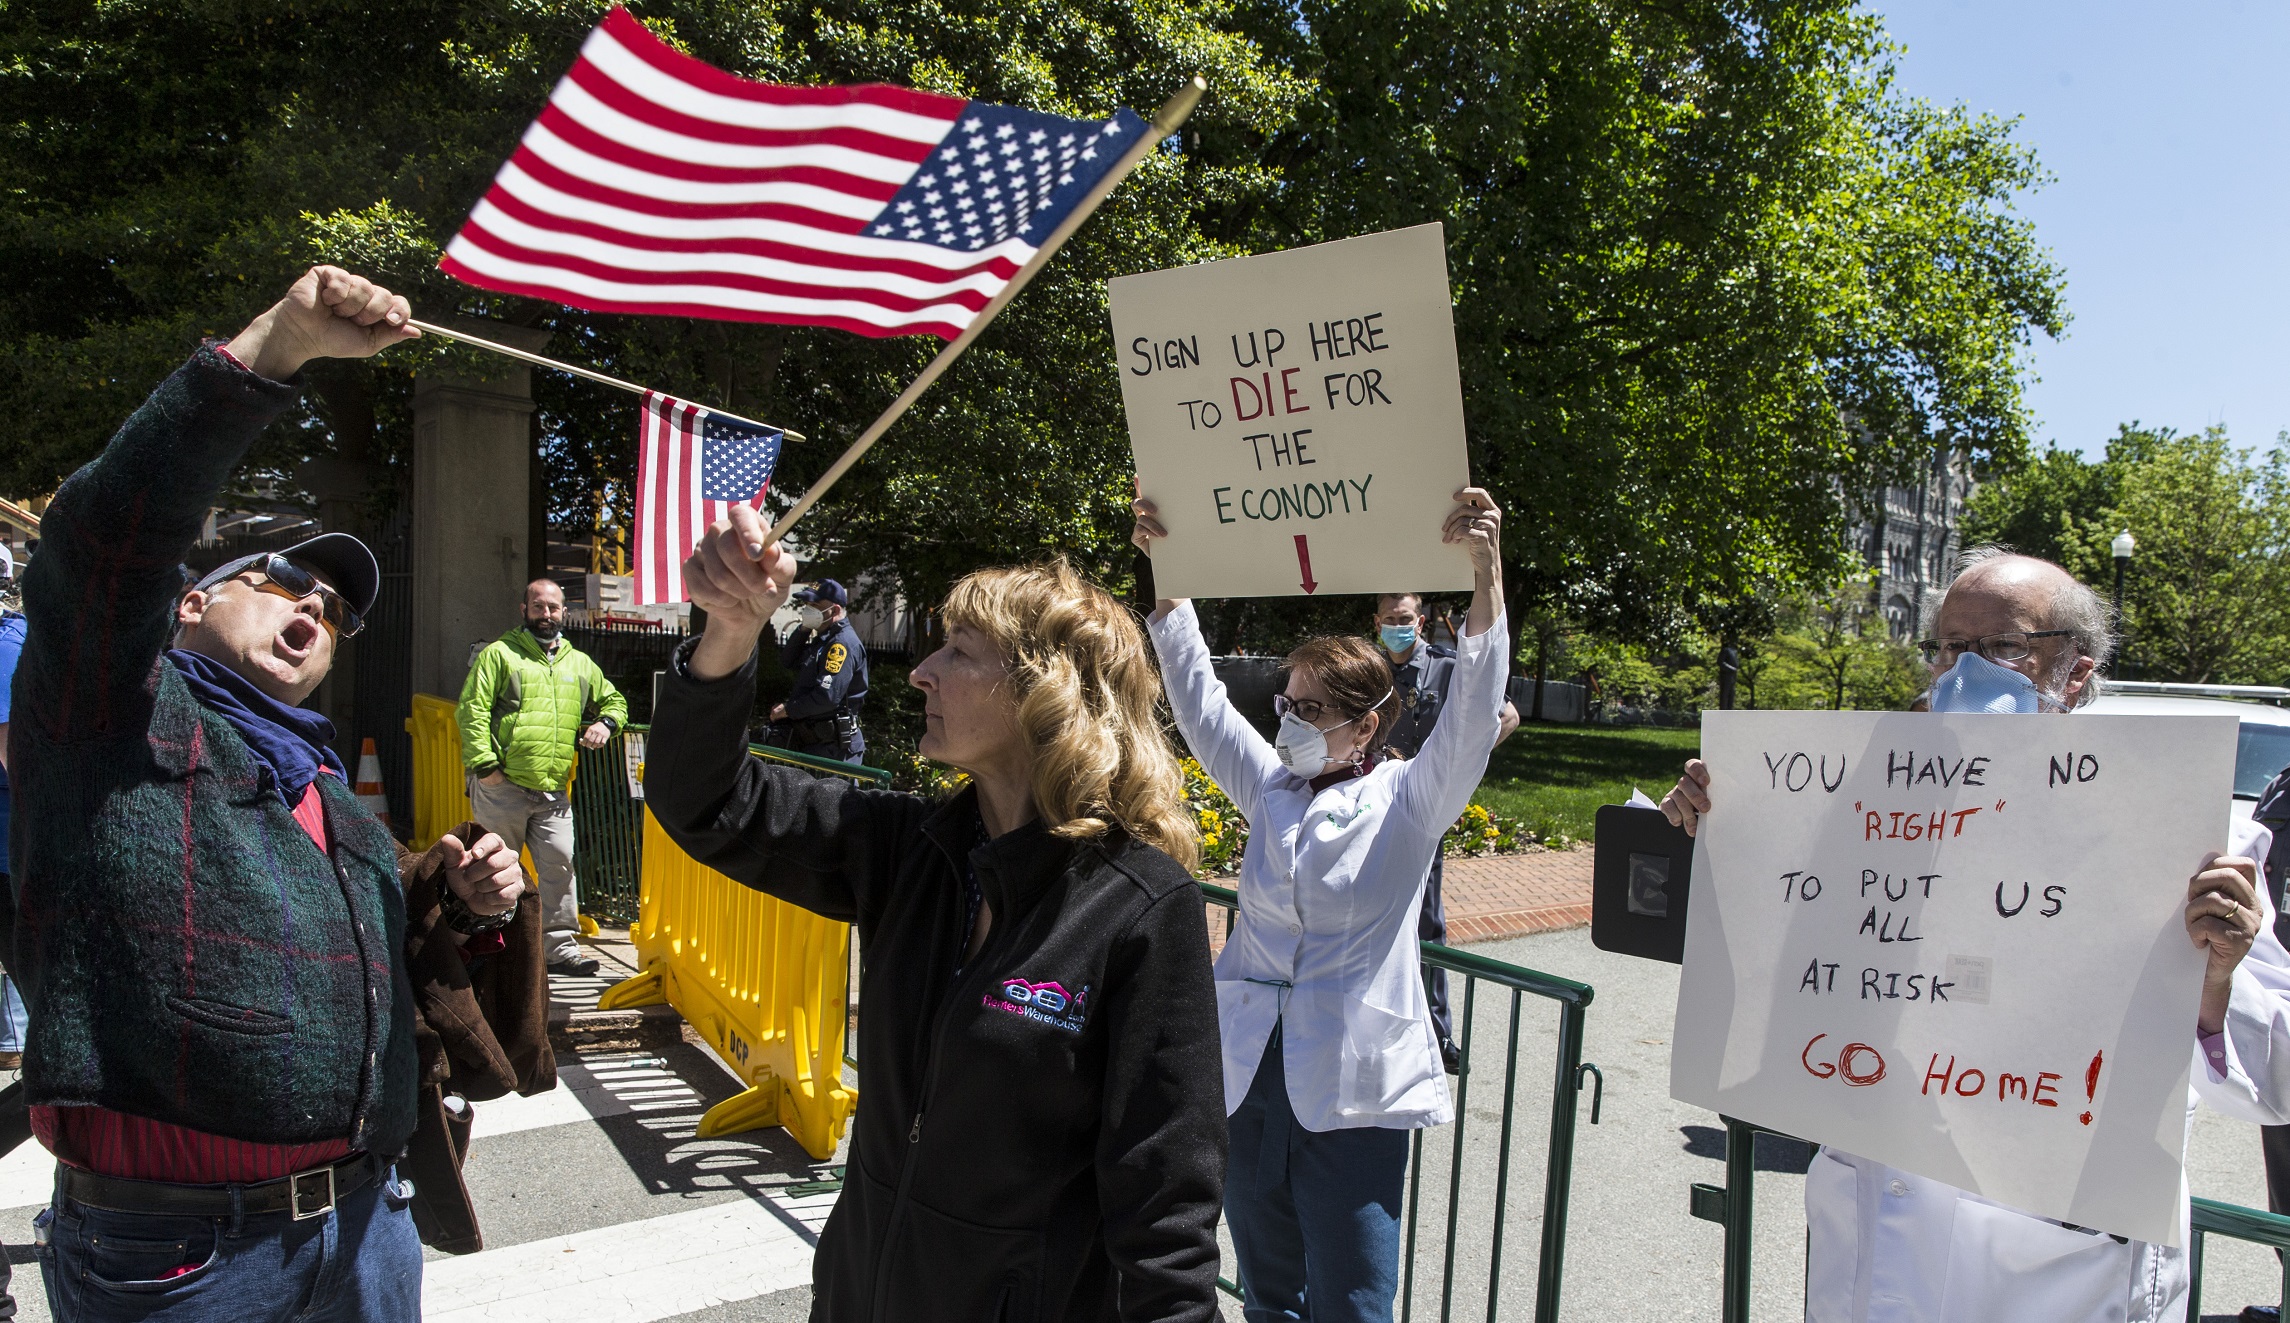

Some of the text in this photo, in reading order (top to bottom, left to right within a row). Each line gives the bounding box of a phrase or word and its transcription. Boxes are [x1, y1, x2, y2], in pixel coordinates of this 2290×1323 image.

[1130, 312, 1390, 377] SIGN UP HERE
[1177, 367, 1393, 431] TO DIE FOR
[1242, 429, 1317, 471] THE
[1213, 473, 1373, 525] ECONOMY
[1763, 749, 2099, 793] YOU HAVE NO
[1779, 868, 2068, 919] TO PUT US
[1859, 905, 1923, 943] ALL
[1799, 958, 1956, 1003] AT RISK
[983, 994, 1083, 1031] RentersWarehouse
[730, 1029, 749, 1066] DCP
[1801, 1033, 1887, 1087] GO
